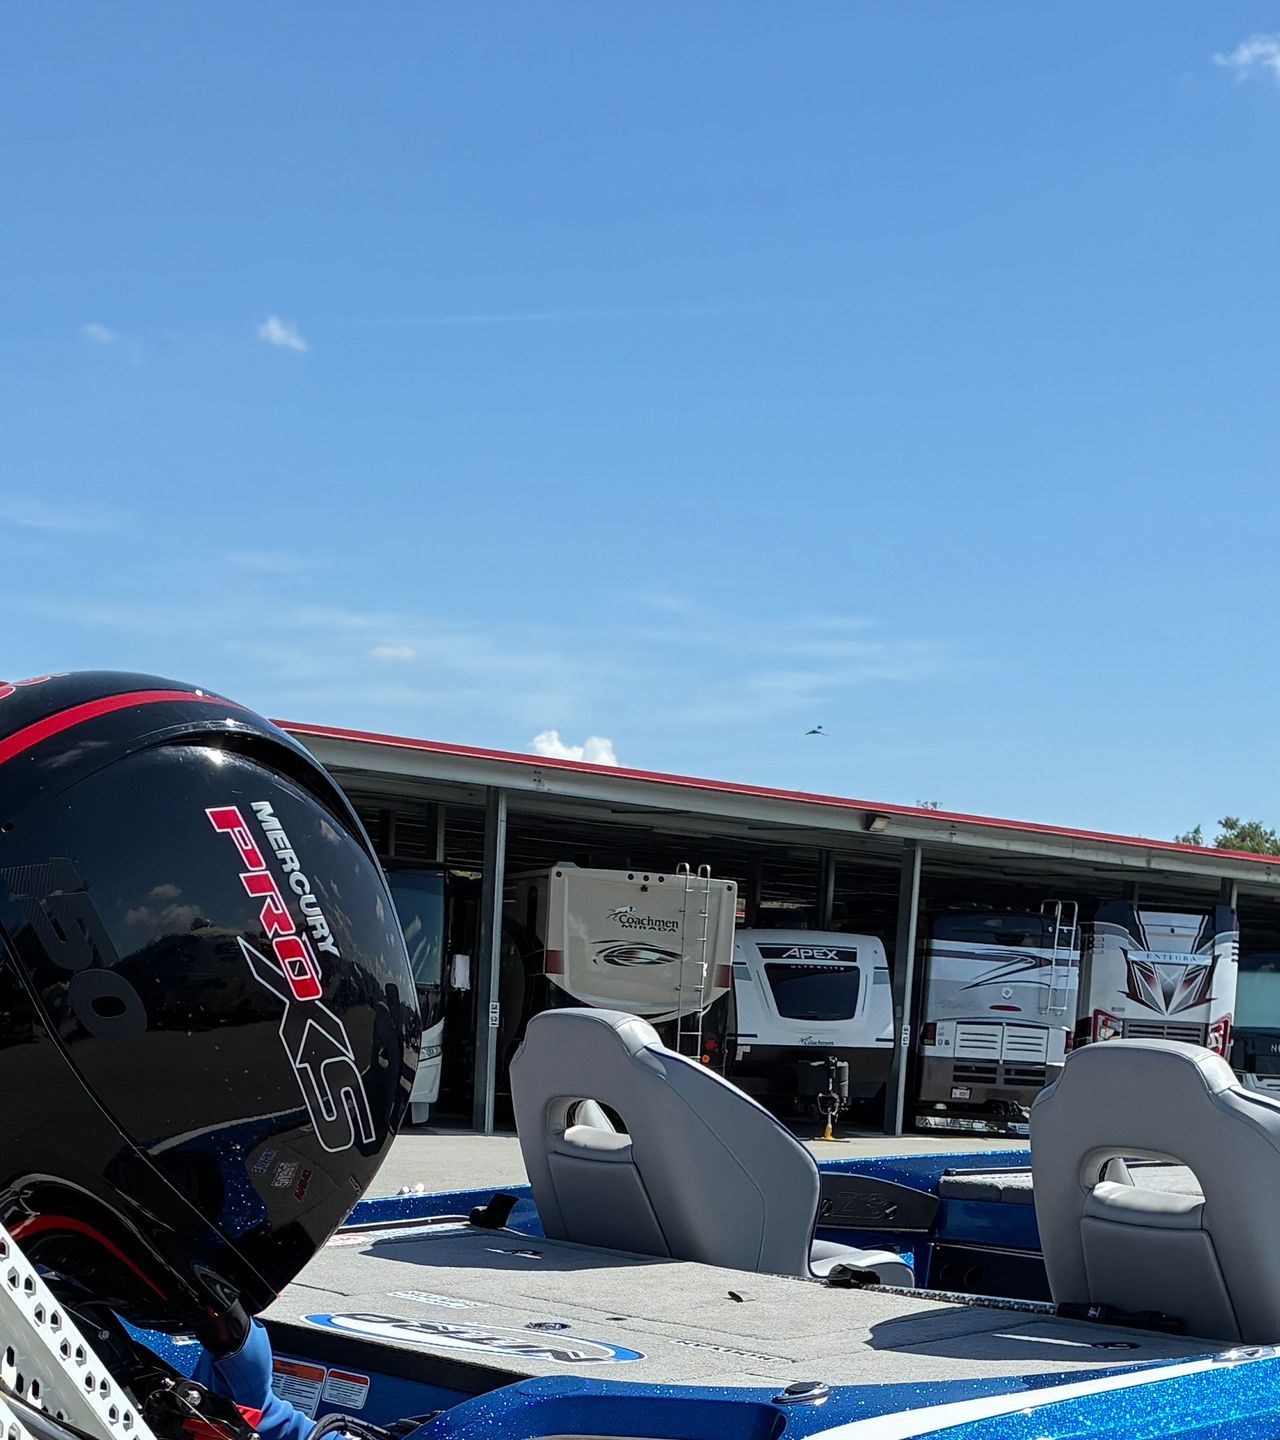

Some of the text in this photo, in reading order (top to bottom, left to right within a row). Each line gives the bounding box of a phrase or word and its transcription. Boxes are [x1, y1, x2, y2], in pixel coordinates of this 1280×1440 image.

[0, 857, 148, 1040] 150
[251, 801, 341, 959] MERCURY
[619, 914, 679, 928] Coachmen
[782, 947, 839, 960] APEX
[205, 805, 377, 1153] PRO XS
